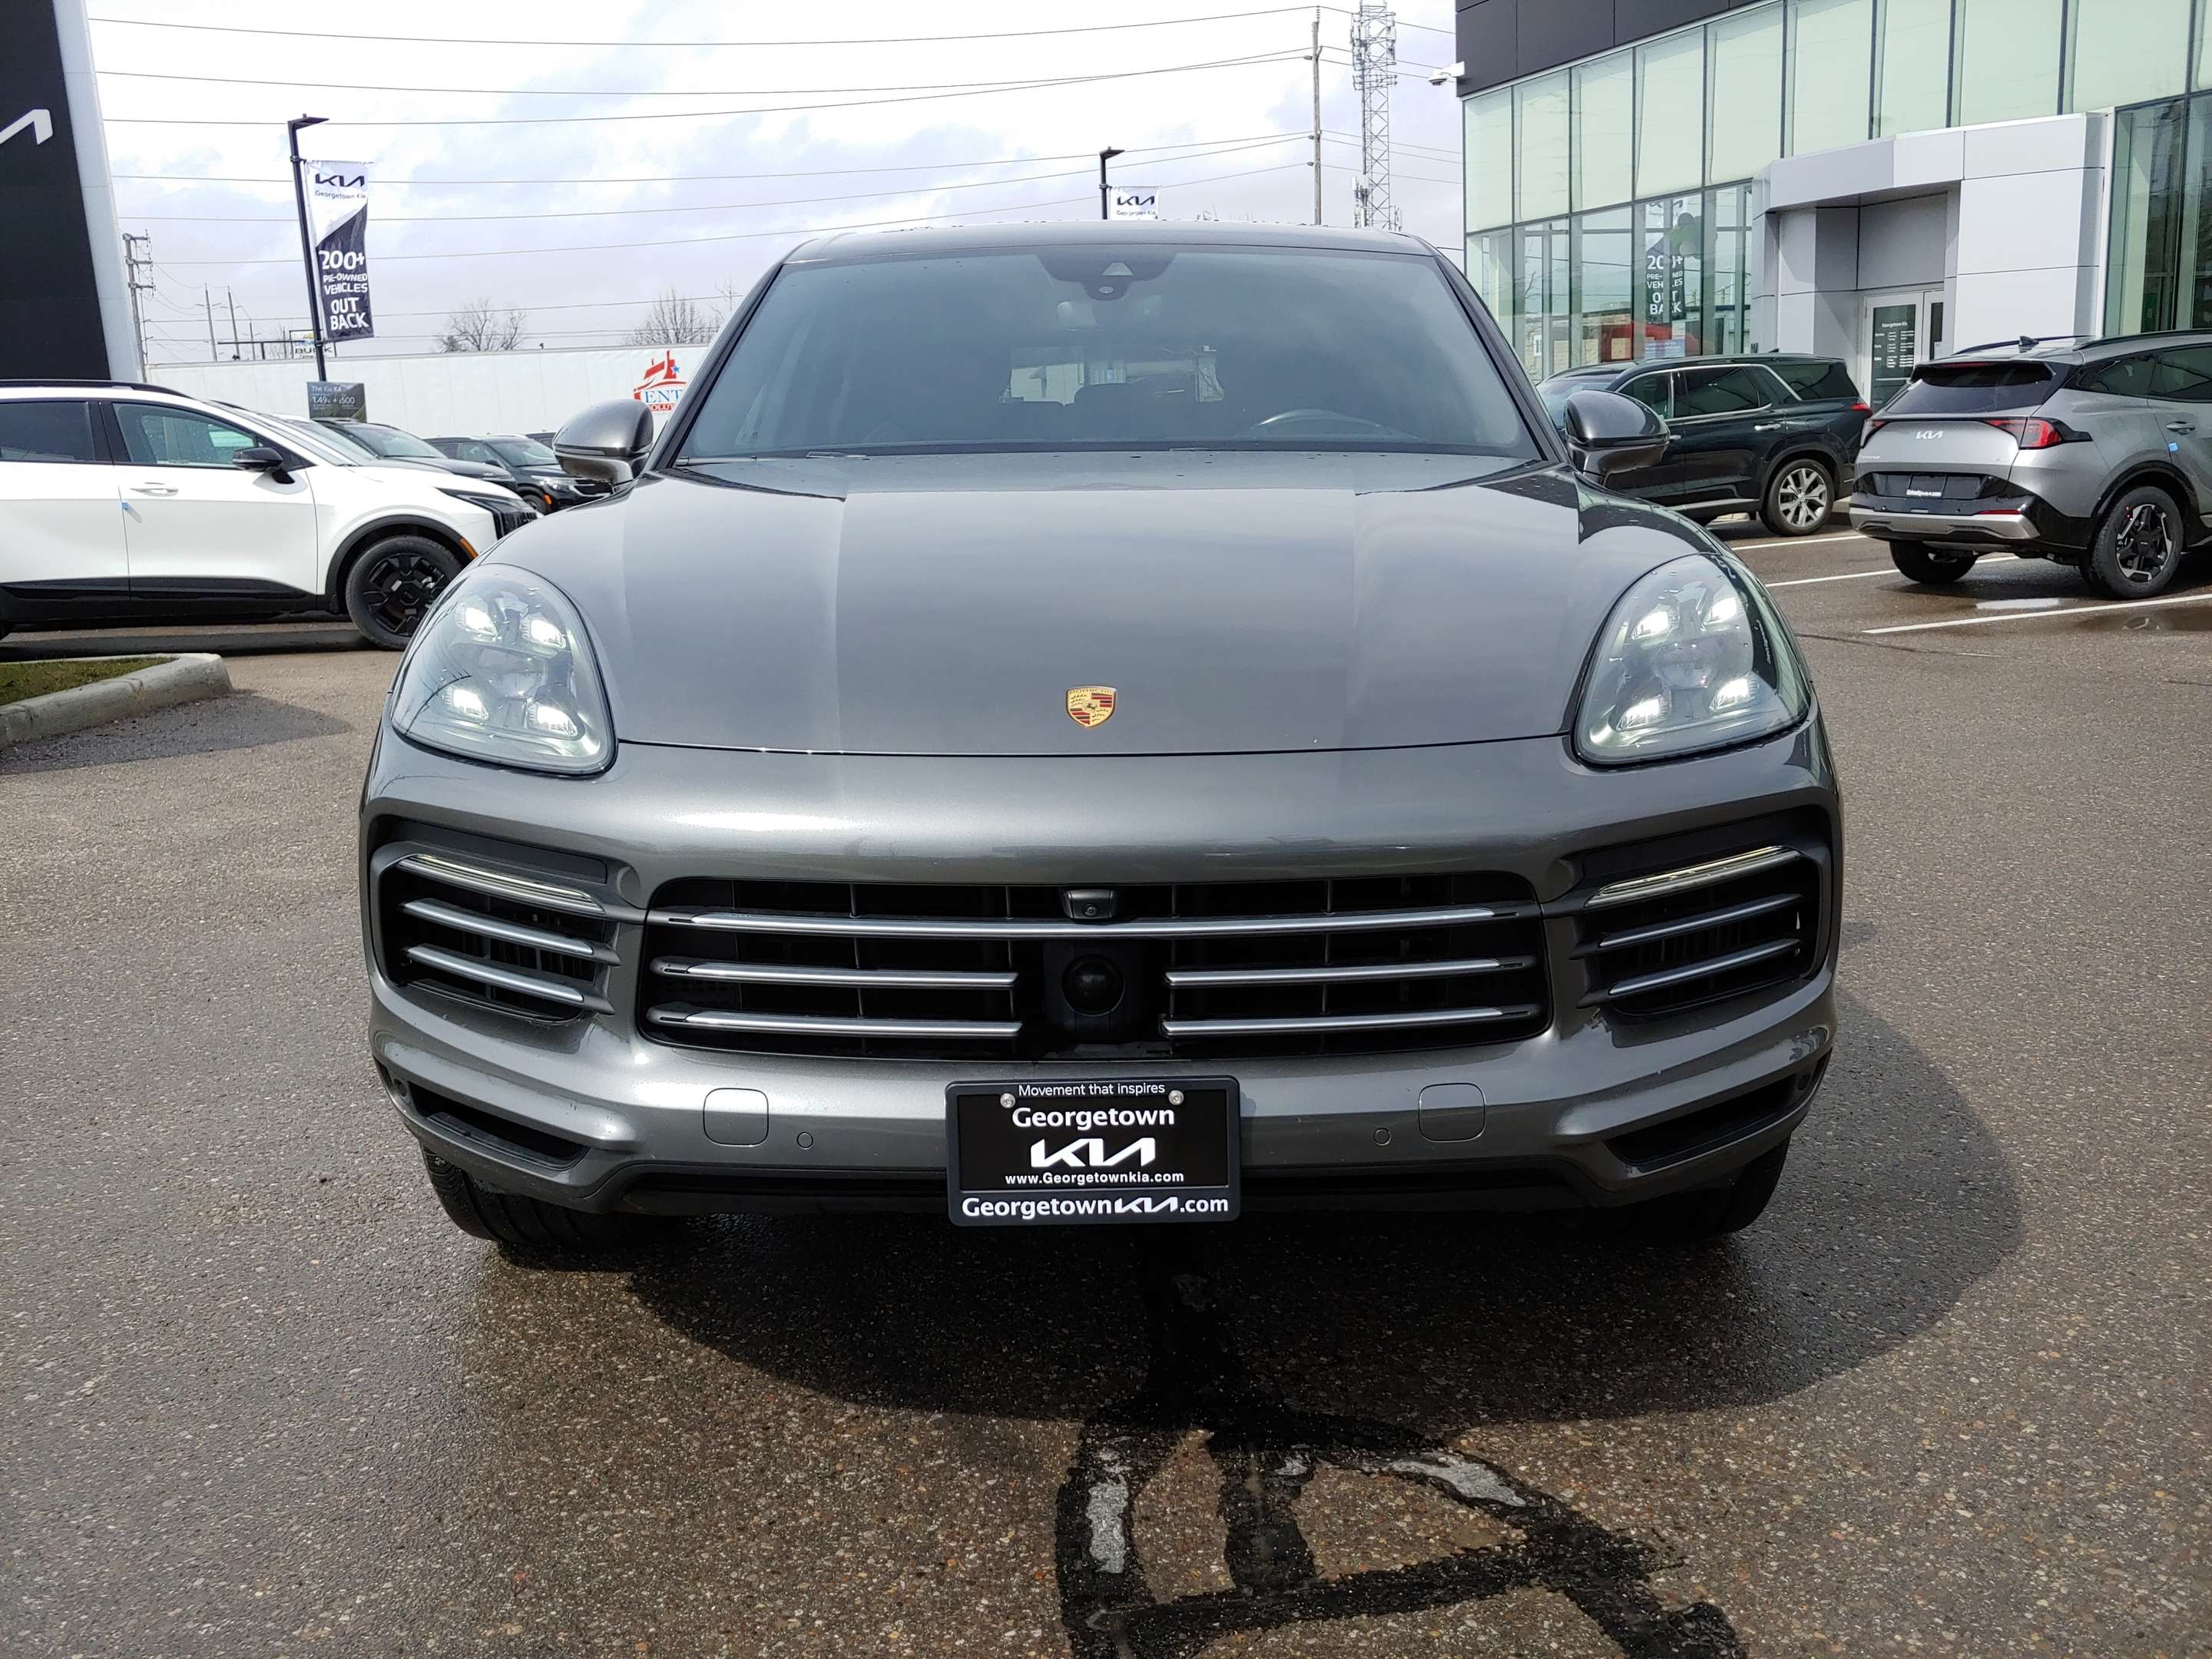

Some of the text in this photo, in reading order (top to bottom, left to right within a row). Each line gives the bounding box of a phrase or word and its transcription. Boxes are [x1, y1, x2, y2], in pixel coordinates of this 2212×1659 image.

[315, 174, 365, 187] KIA
[1117, 195, 1155, 206] KIA
[318, 250, 365, 270] 200+
[323, 283, 368, 295] VEHICLES
[330, 296, 359, 315] OUT
[329, 312, 369, 331] BACK
[1916, 431, 1944, 439] KIA
[1018, 1082, 1166, 1097] Movement that inspires
[1012, 1107, 1175, 1131] Georgetown
[1030, 1137, 1156, 1167] KIA
[1005, 1171, 1185, 1186] www.Georgetownkia.com
